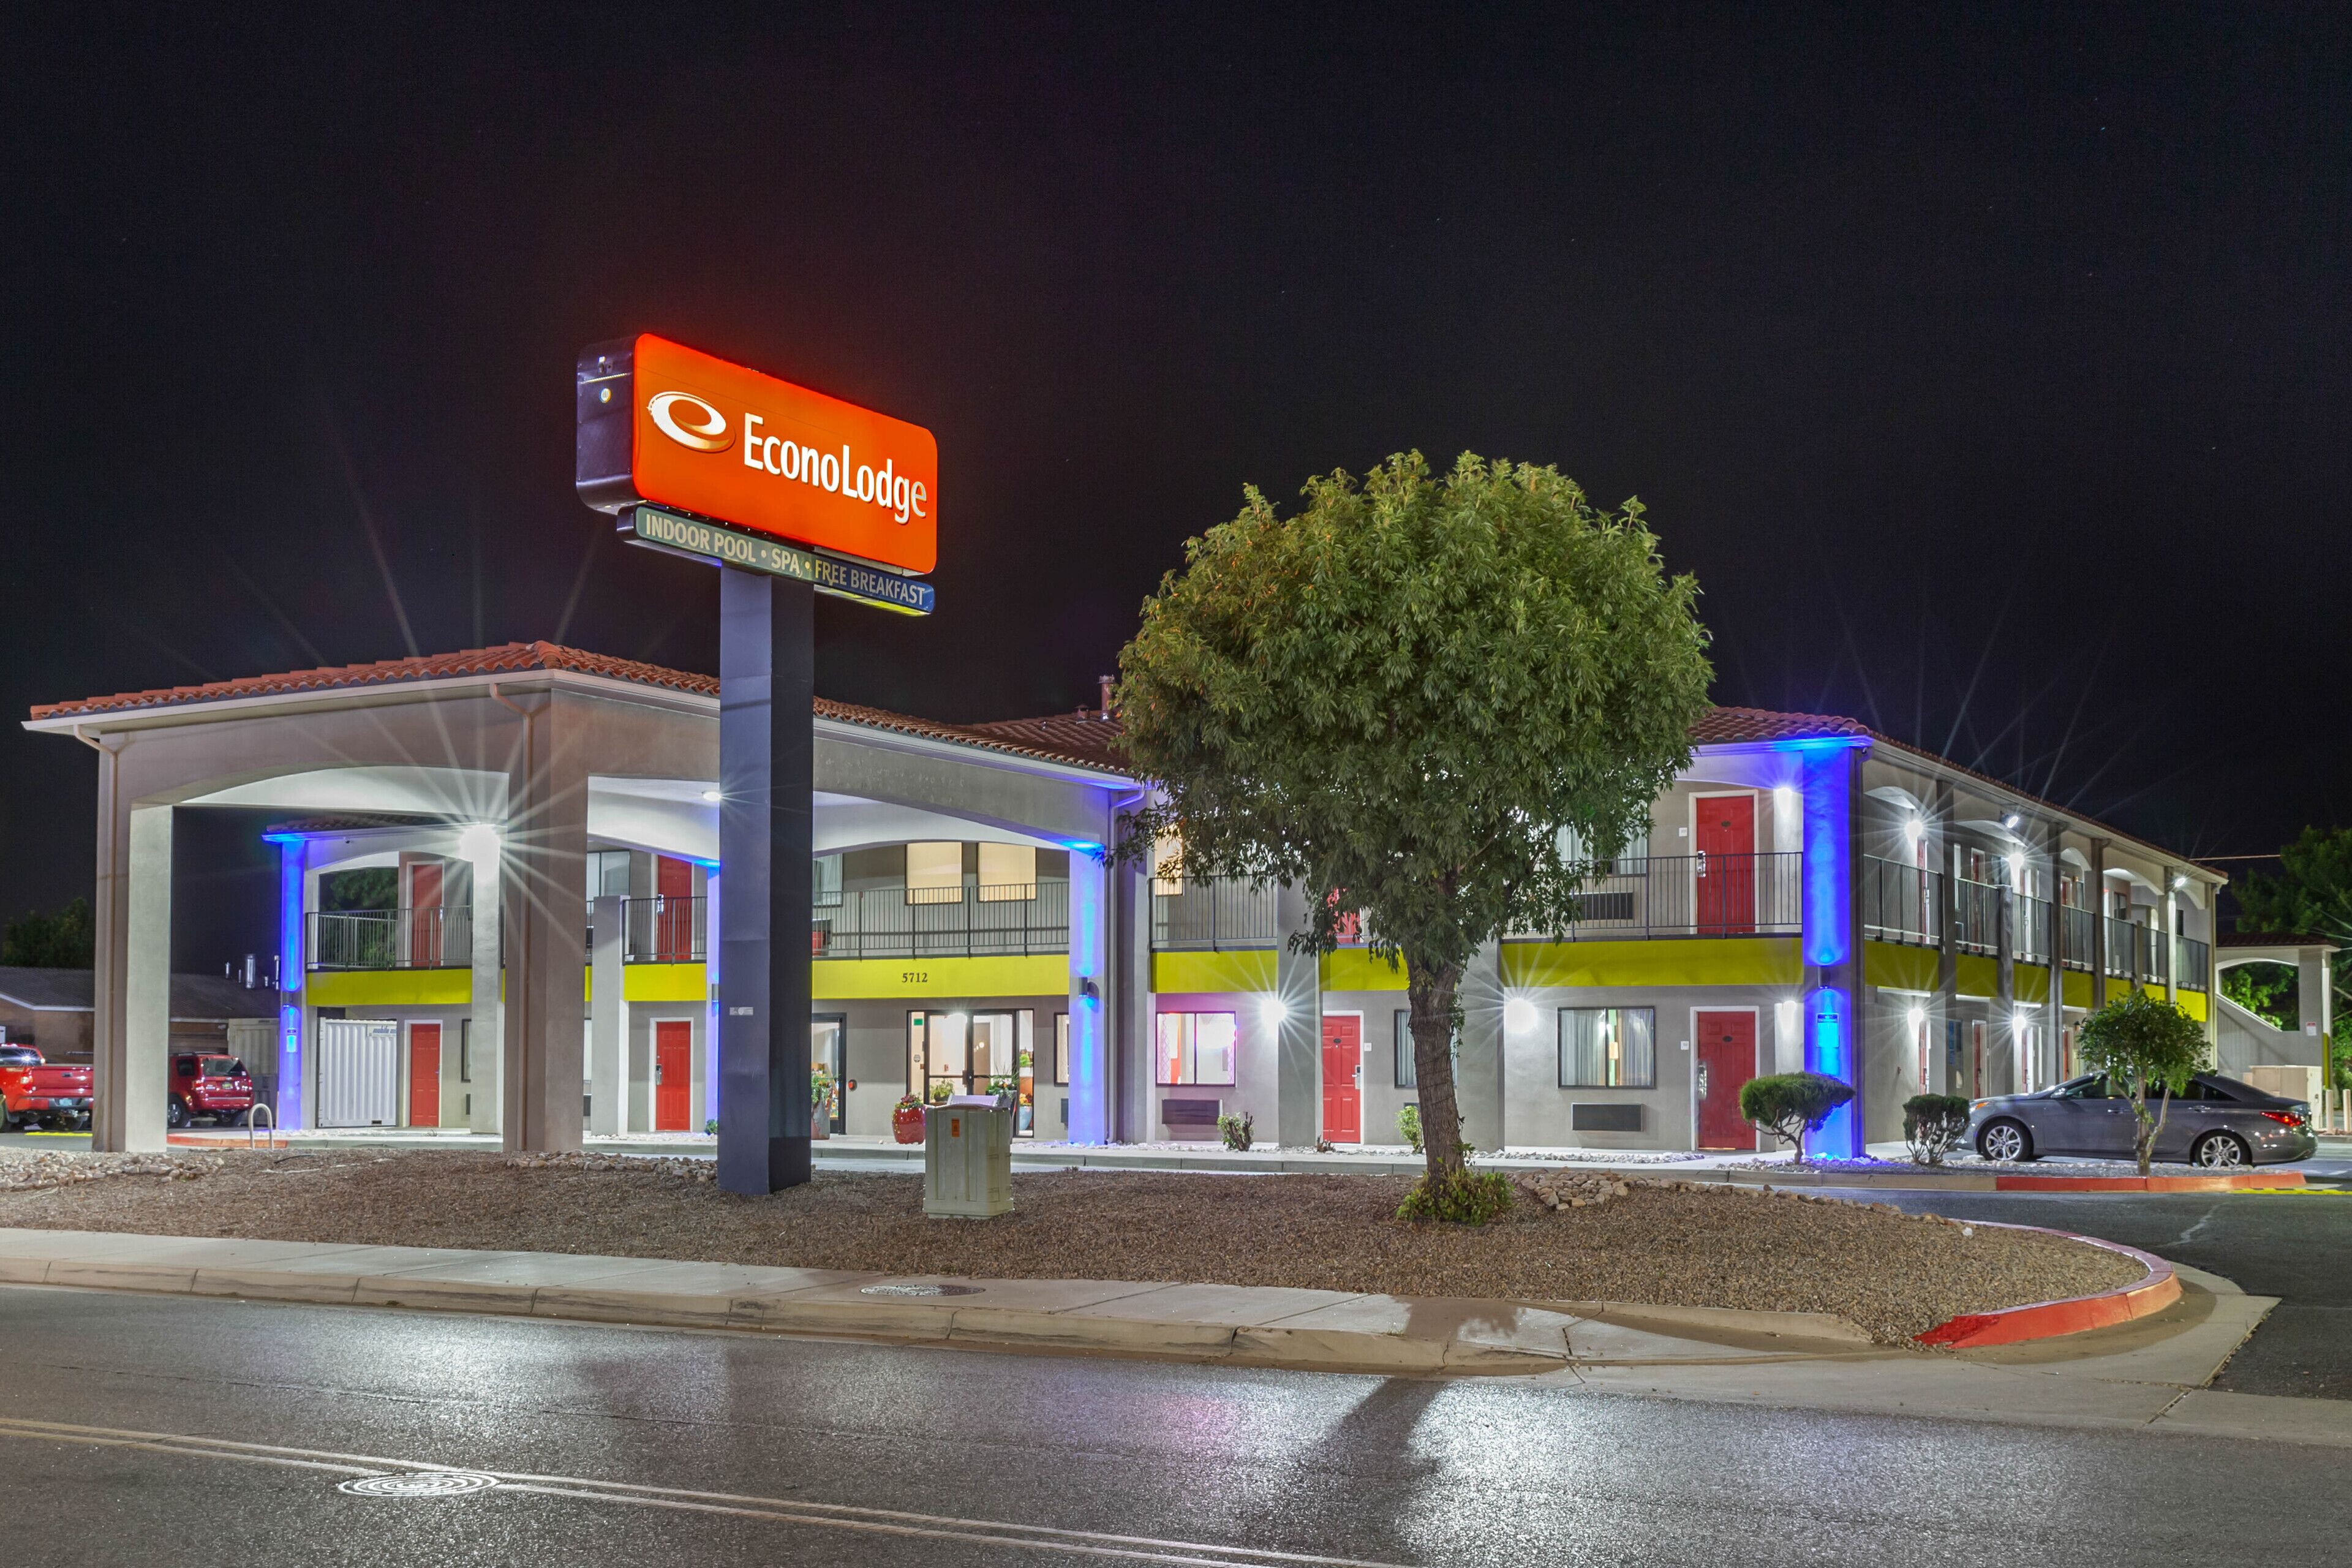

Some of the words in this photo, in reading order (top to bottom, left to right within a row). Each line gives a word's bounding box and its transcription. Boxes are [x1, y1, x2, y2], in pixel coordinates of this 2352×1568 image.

[744, 412, 927, 524] EconoLodge
[646, 514, 710, 551] INDOOR
[714, 531, 756, 562] POOL
[772, 549, 801, 574] SPA
[815, 560, 847, 586] FREE
[851, 570, 925, 605] BREAKFAST
[902, 972, 928, 983] 5712
